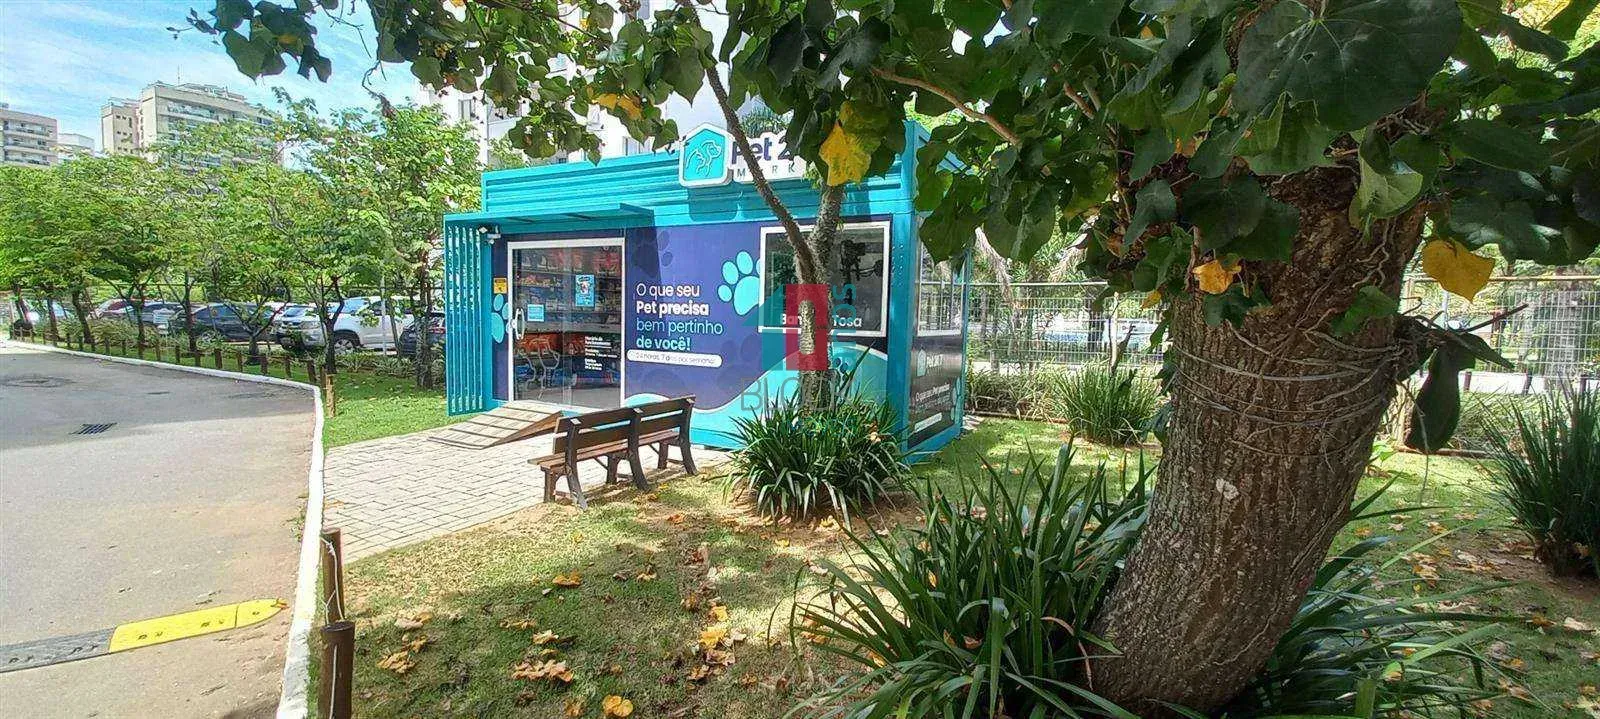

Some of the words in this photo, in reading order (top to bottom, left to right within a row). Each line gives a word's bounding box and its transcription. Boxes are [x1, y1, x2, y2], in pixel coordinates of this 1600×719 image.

[636, 283, 647, 296] O
[649, 284, 674, 301] que
[676, 285, 700, 297] seu
[636, 300, 657, 314] Pet
[658, 299, 710, 319] precisa
[636, 317, 665, 331] bem
[668, 318, 723, 336] pertinho
[636, 335, 652, 349] de
[654, 336, 692, 351] você!
